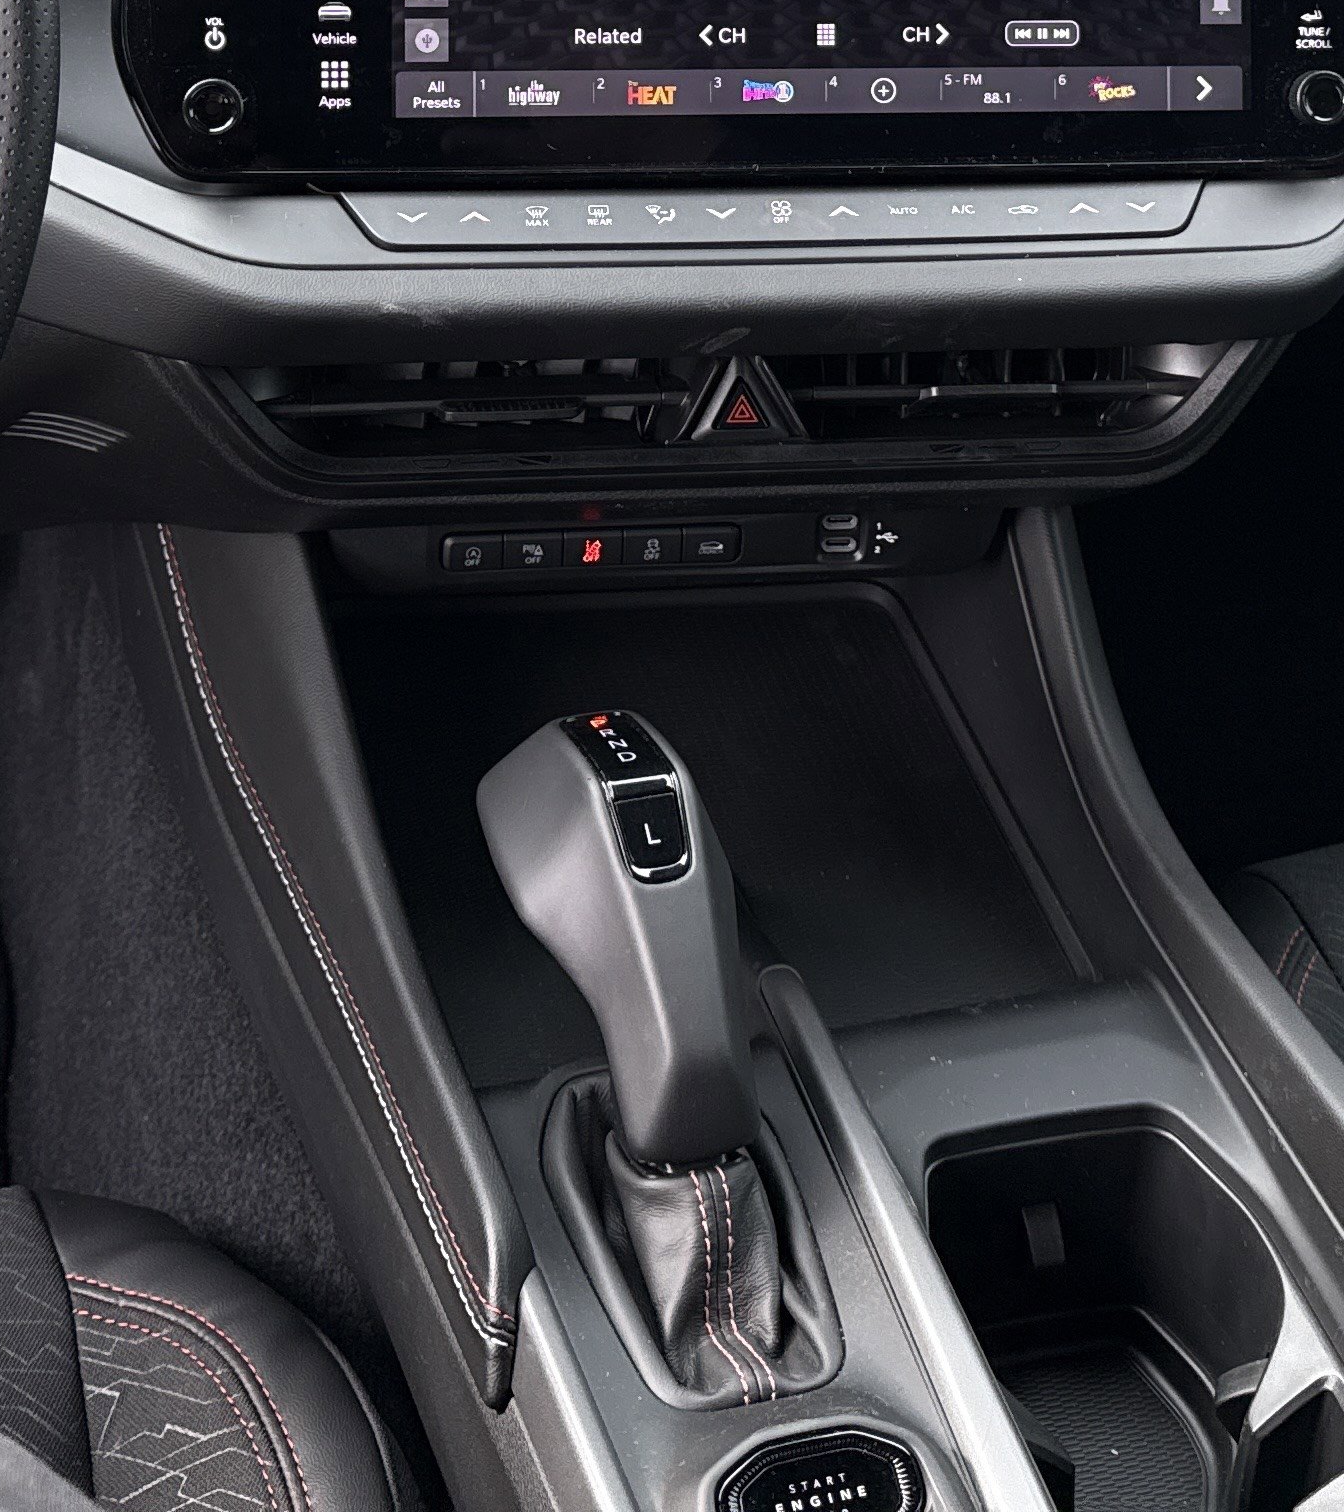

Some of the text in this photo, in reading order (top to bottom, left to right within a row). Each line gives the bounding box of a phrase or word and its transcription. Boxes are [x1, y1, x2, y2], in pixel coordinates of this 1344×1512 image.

[205, 17, 224, 26] VOL
[312, 32, 357, 45] Vehicle
[574, 27, 642, 45] Related
[718, 27, 746, 44] CH
[902, 27, 930, 43] CH
[1295, 38, 1333, 49] SCROLL
[479, 79, 486, 90] 1
[596, 78, 605, 90] 2
[713, 77, 722, 88] 3
[828, 75, 838, 87] 4
[963, 74, 982, 85] FM
[1058, 74, 1067, 85] 6
[427, 80, 445, 93] All
[508, 85, 560, 104] highway
[627, 86, 677, 105] HEAT
[983, 92, 1011, 104] 88.1
[318, 96, 352, 109] Apps
[412, 96, 461, 110] Presets
[889, 206, 918, 215] AUTO
[951, 205, 976, 215] A/C
[525, 219, 549, 227] MAX
[587, 218, 613, 226] REAR
[773, 216, 790, 224] OFF
[464, 558, 481, 567] OFF
[524, 556, 542, 565] OFF
[599, 728, 616, 738] R
[607, 738, 629, 749] N
[617, 751, 637, 763] D
[644, 822, 662, 845] L
[788, 1472, 847, 1495] START
[774, 1484, 868, 1512] ENGINE
